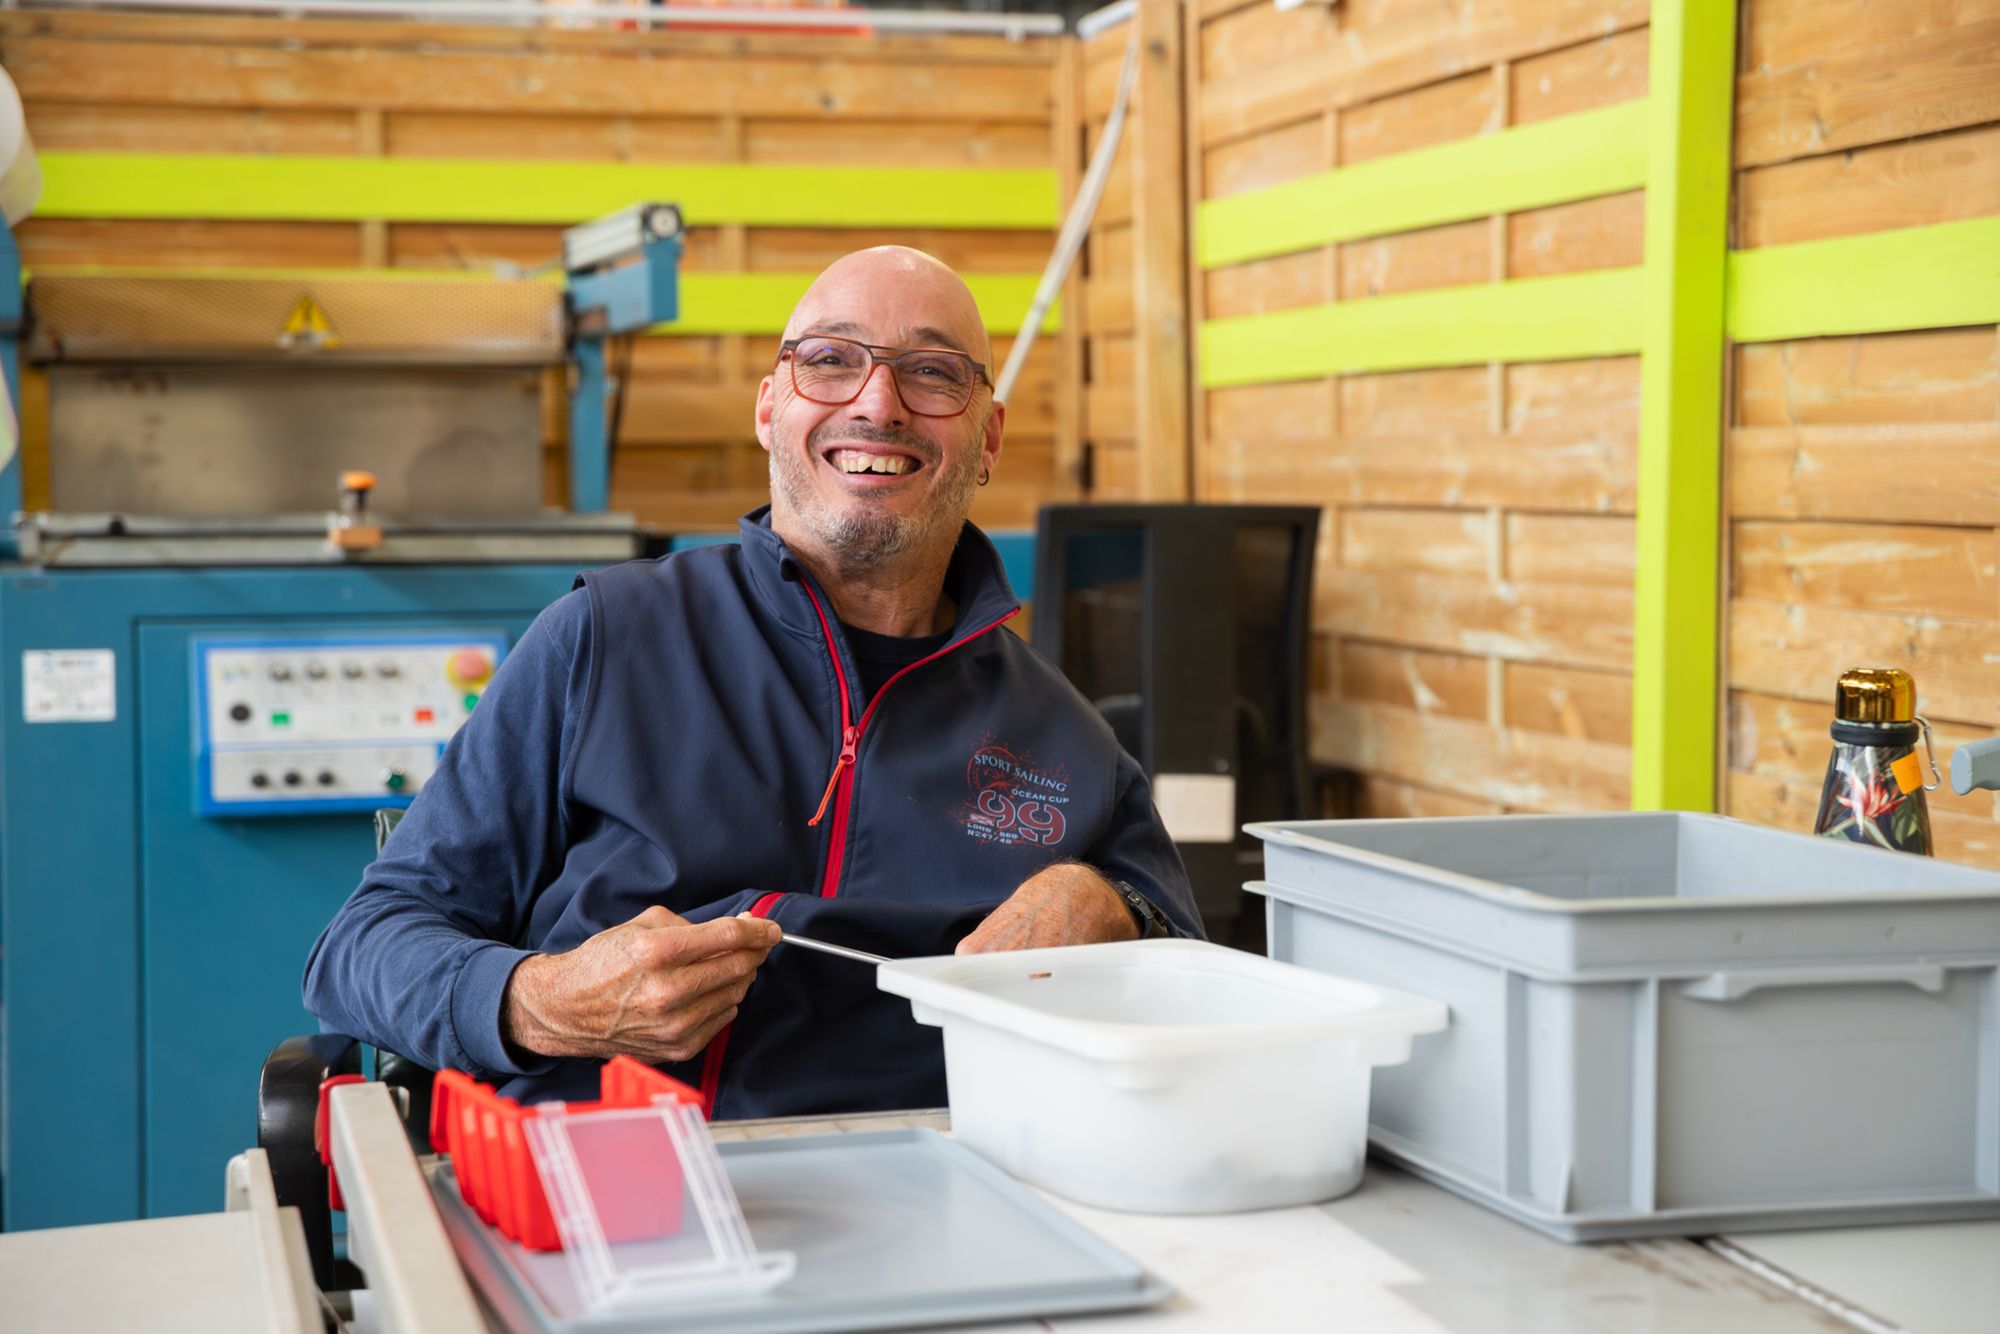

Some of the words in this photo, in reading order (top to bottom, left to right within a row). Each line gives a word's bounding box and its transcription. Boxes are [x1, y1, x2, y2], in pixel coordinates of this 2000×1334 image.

[974, 754, 1012, 773] SPORT
[1014, 767, 1067, 792] SAILING
[1011, 788, 1046, 801] OCEAN
[1048, 796, 1069, 804] CUP
[978, 789, 1066, 845] 99
